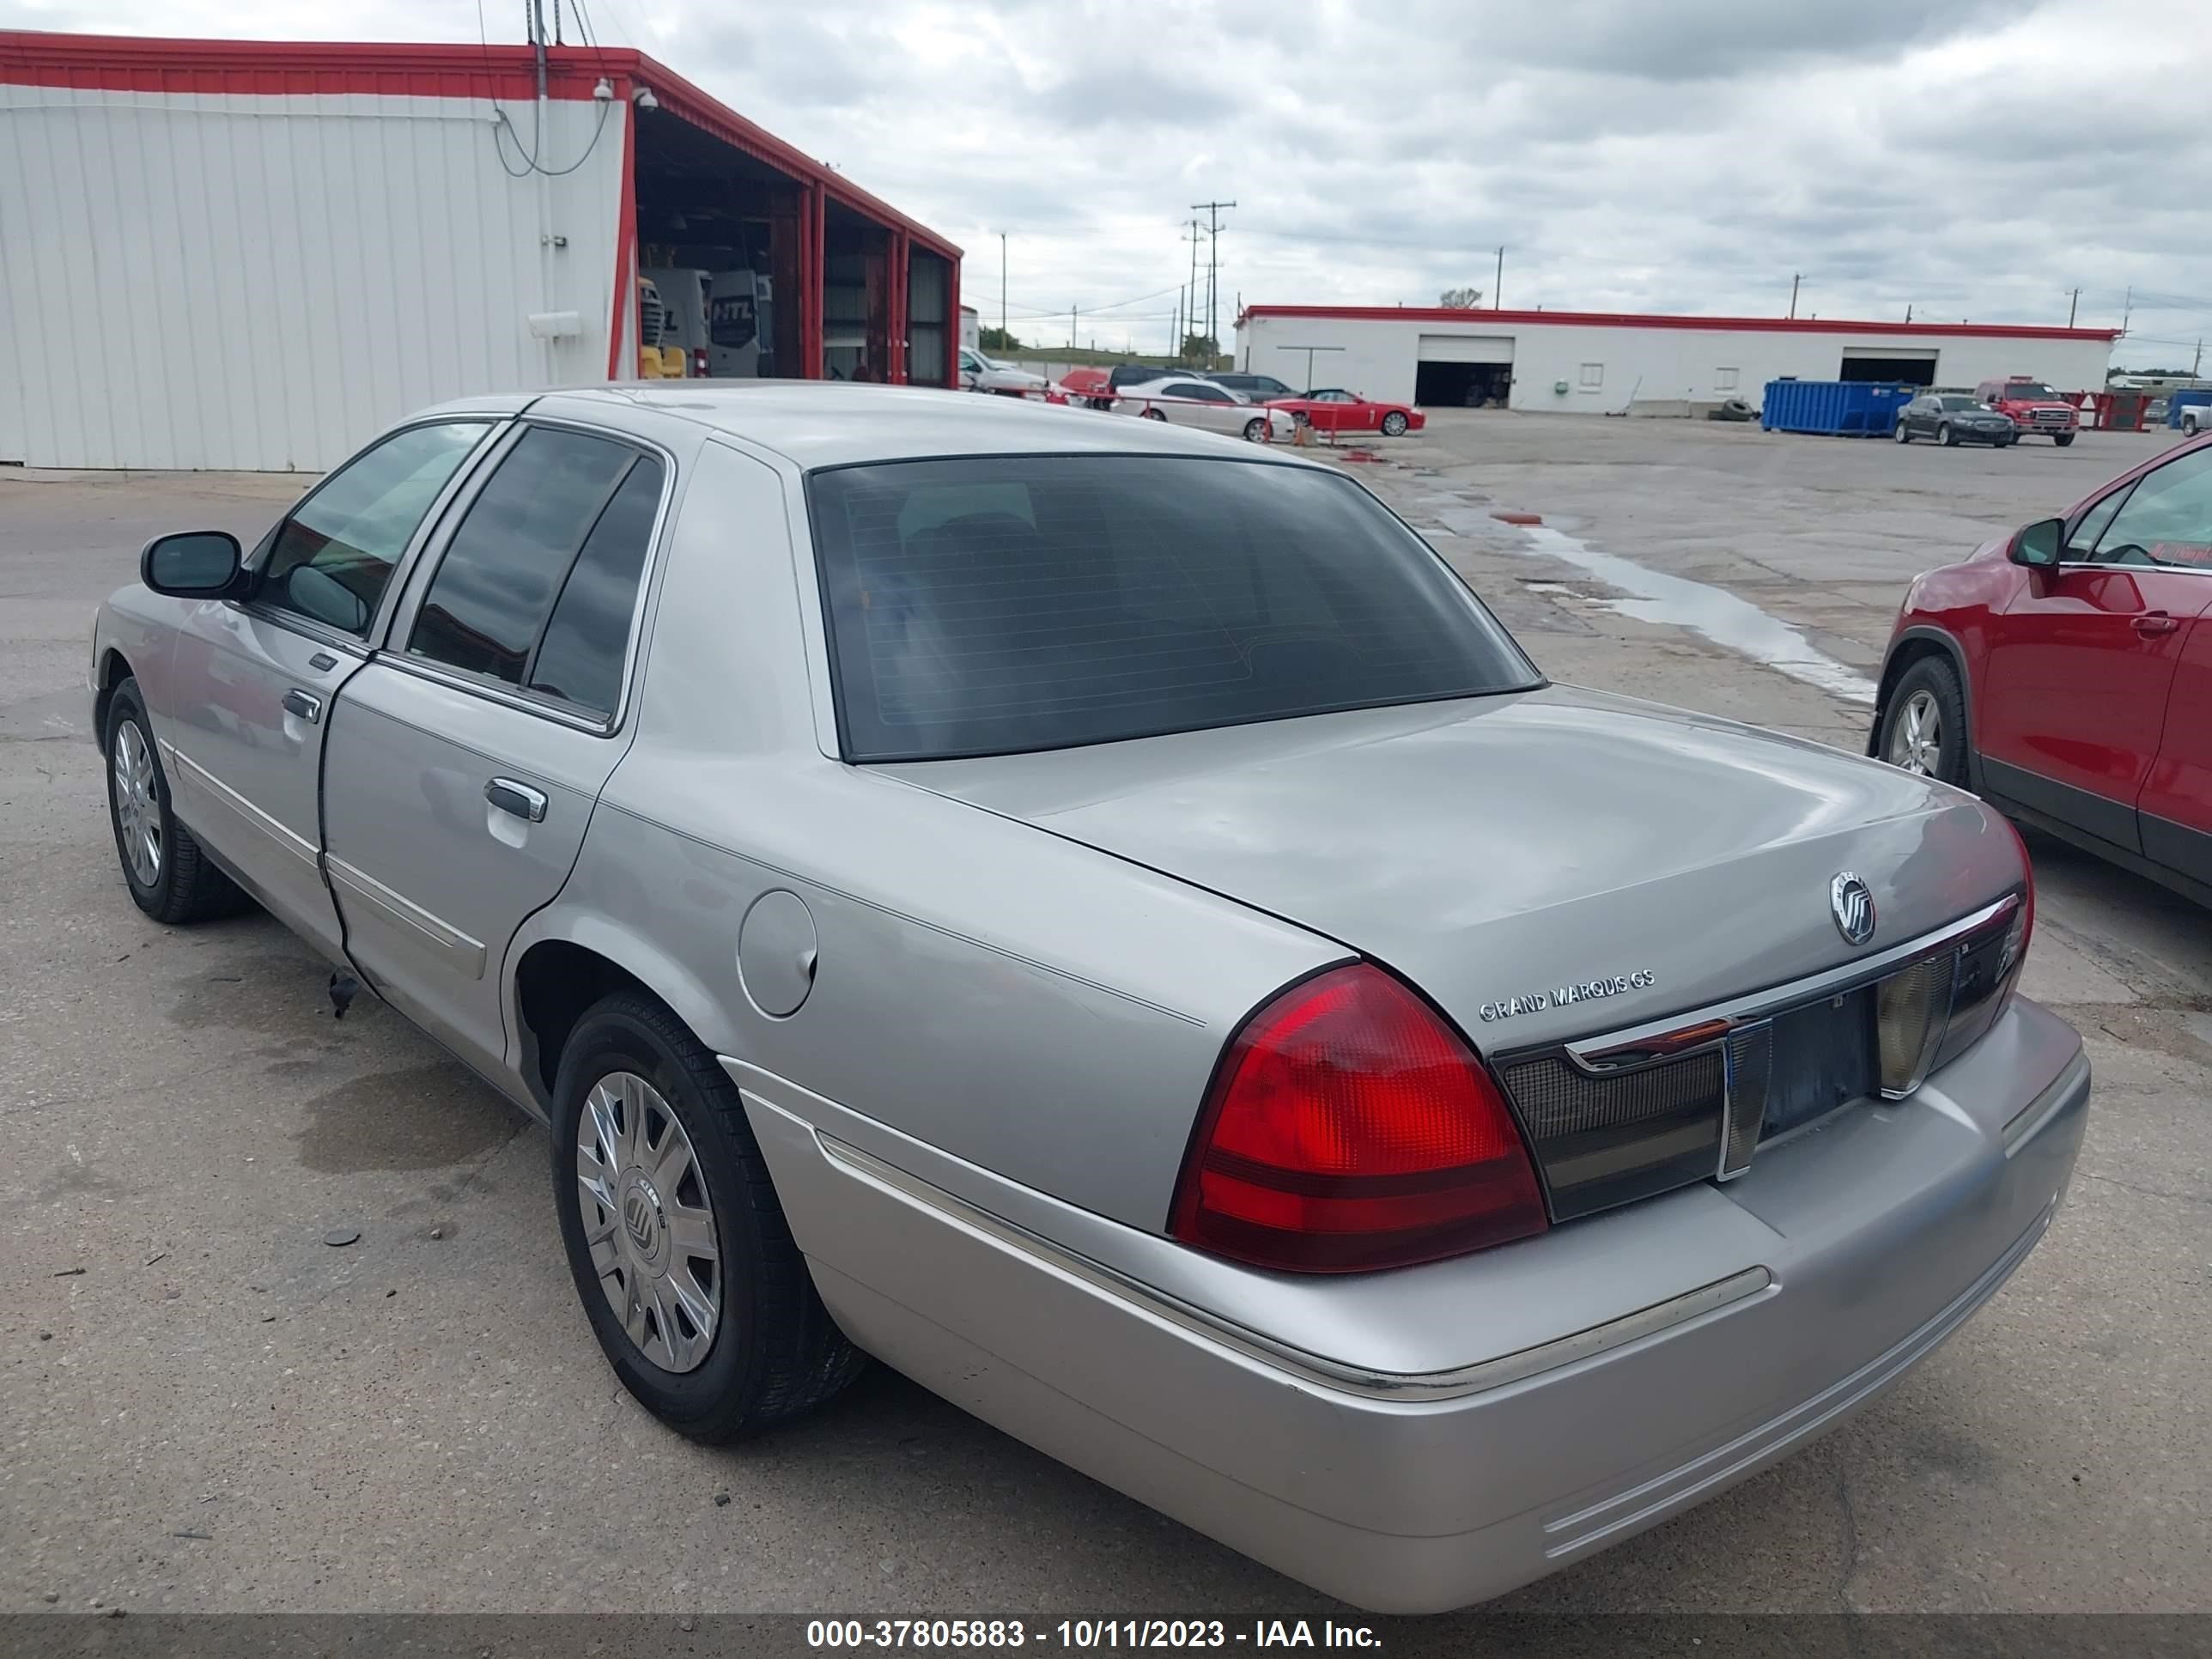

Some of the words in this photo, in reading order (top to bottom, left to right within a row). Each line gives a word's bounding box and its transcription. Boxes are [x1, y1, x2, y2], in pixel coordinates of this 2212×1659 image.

[1479, 994, 1547, 1022] GRAND
[1549, 975, 1628, 1007] MARQUIS
[1630, 968, 1656, 989] GS
